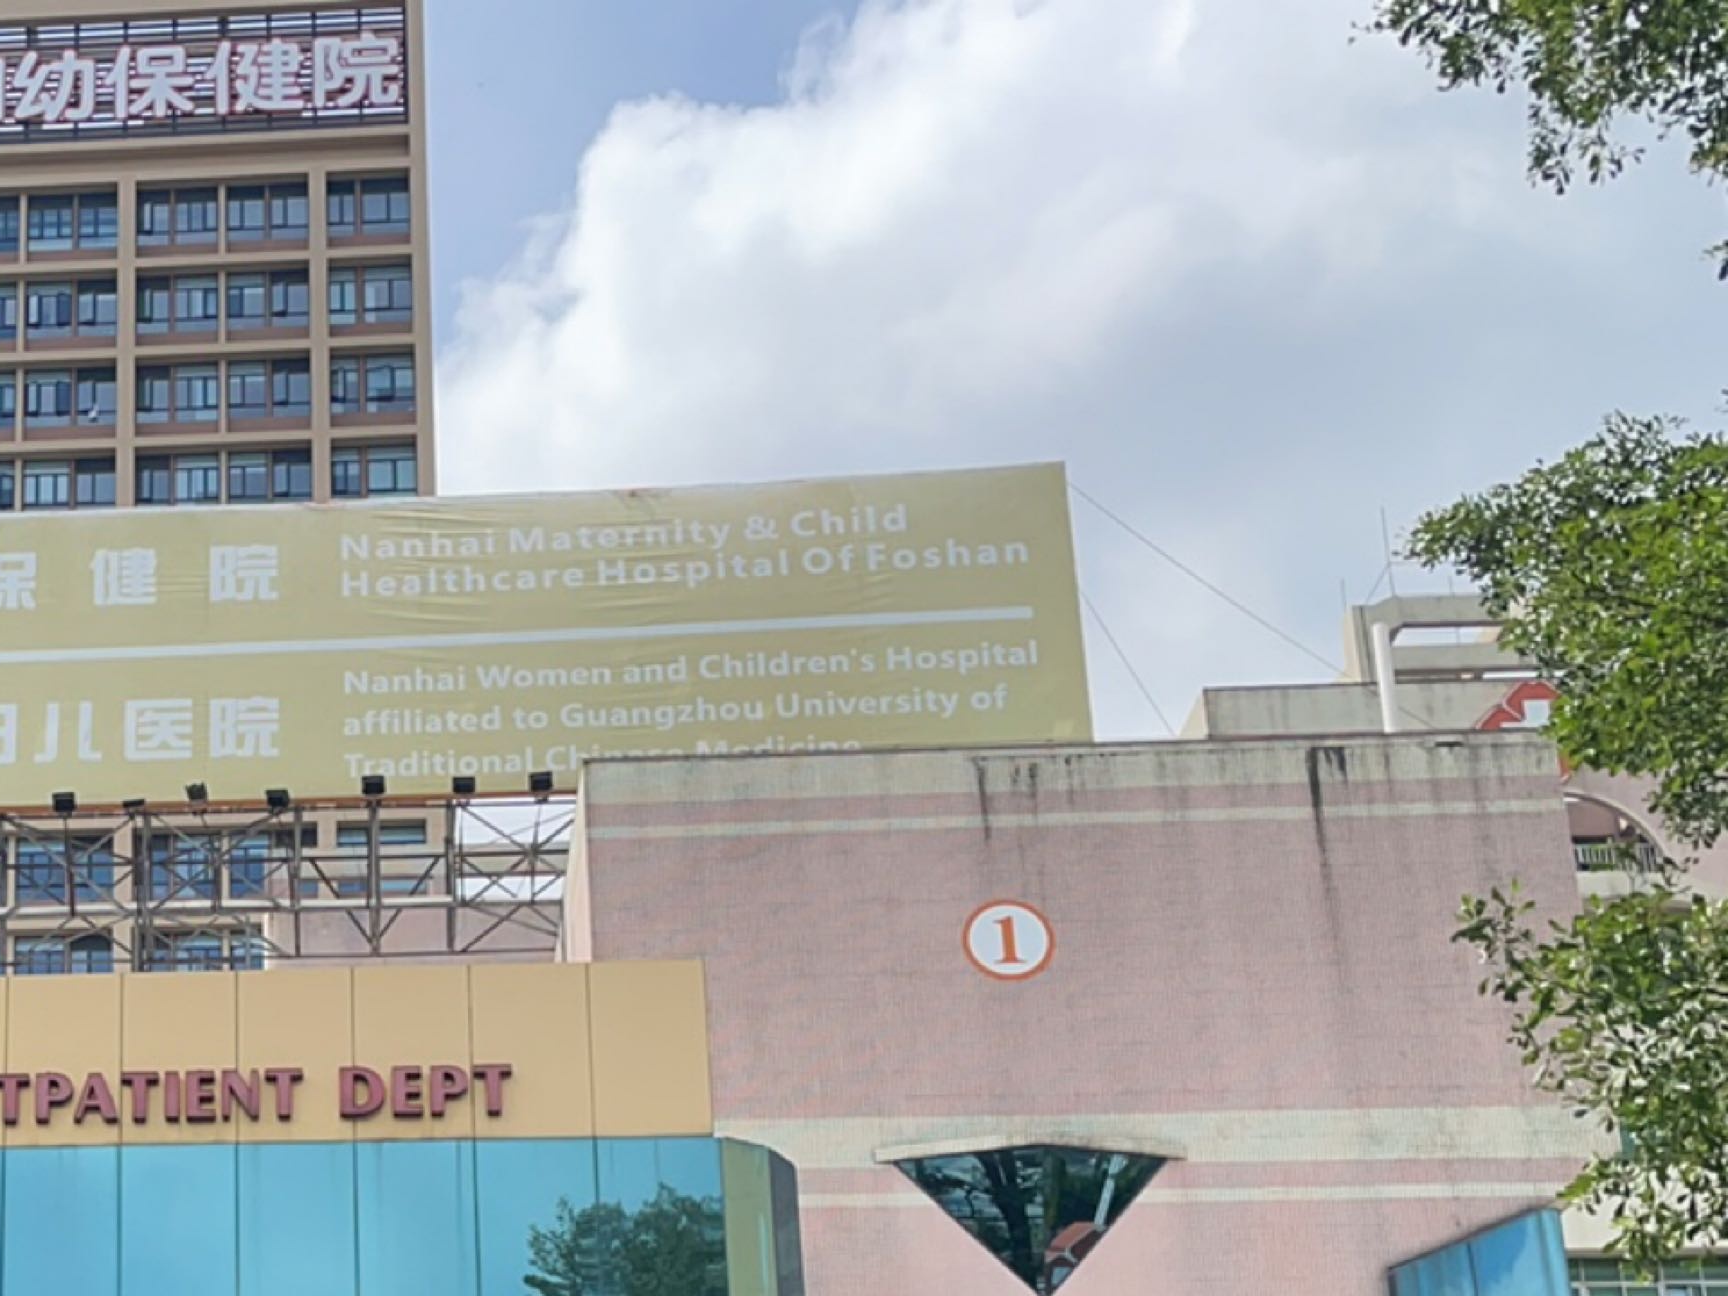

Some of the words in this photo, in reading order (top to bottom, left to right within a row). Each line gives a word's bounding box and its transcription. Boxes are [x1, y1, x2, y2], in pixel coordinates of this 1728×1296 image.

[340, 528, 494, 561] Nanhai
[508, 518, 731, 553] Maternity
[745, 514, 780, 542] &
[790, 502, 908, 538] Child
[341, 565, 585, 597] Healthcare
[597, 547, 791, 589] Hospital
[801, 544, 854, 576] Of
[865, 538, 1030, 573] Foshan
[344, 666, 466, 694] Nanhai
[476, 664, 612, 689] Women
[623, 655, 688, 684] and
[698, 648, 875, 679] Children's
[886, 640, 1039, 676] Hospital
[343, 704, 501, 736] affiliated
[512, 707, 549, 729] to
[559, 697, 765, 731] Guangzhou
[775, 686, 960, 719] University
[971, 683, 1009, 710] of
[343, 746, 534, 779] Traditional
[992, 915, 1028, 964] 1
[339, 1063, 513, 1120] DEPT
